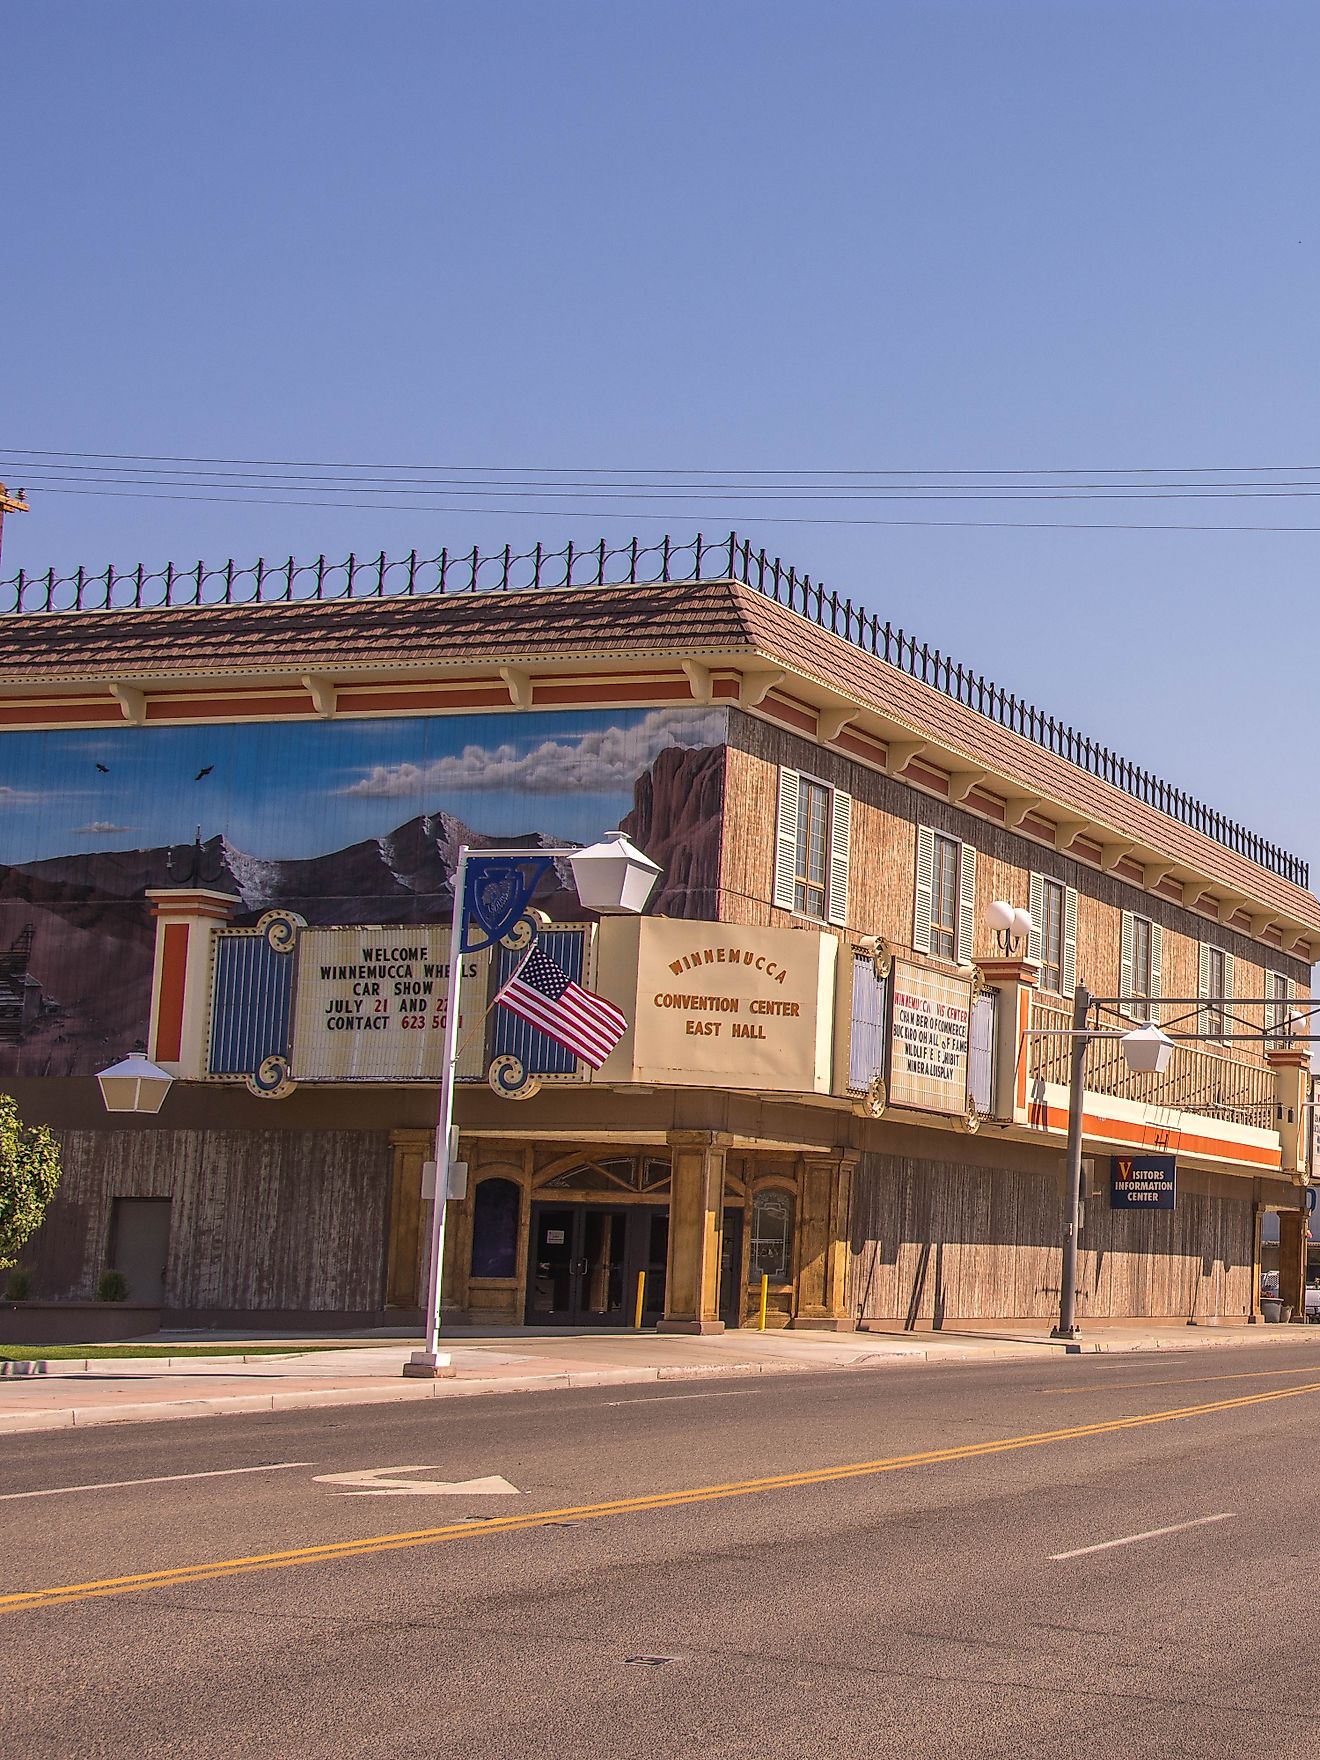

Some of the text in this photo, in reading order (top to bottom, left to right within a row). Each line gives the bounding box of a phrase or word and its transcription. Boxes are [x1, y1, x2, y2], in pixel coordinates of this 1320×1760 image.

[362, 947, 428, 962] WELCOME
[320, 963, 478, 980] WINNEMUCCA WHELS
[668, 948, 787, 985] WINNEMUCCA
[353, 981, 434, 996] CAR SHOW
[325, 999, 363, 1014] JULY
[374, 999, 388, 1013] 21
[399, 998, 428, 1013] AND
[653, 993, 800, 1017] CONVENTION CENTER
[327, 1015, 463, 1031] CONTACT 623 501
[899, 1009, 929, 1029] CHAMBER
[946, 1006, 968, 1023] CENTER
[685, 1020, 767, 1040] EAST HALL
[1118, 1161, 1165, 1180] VISITORS
[1115, 1181, 1173, 1191] INFORMATION
[1127, 1192, 1159, 1201] CENTER
